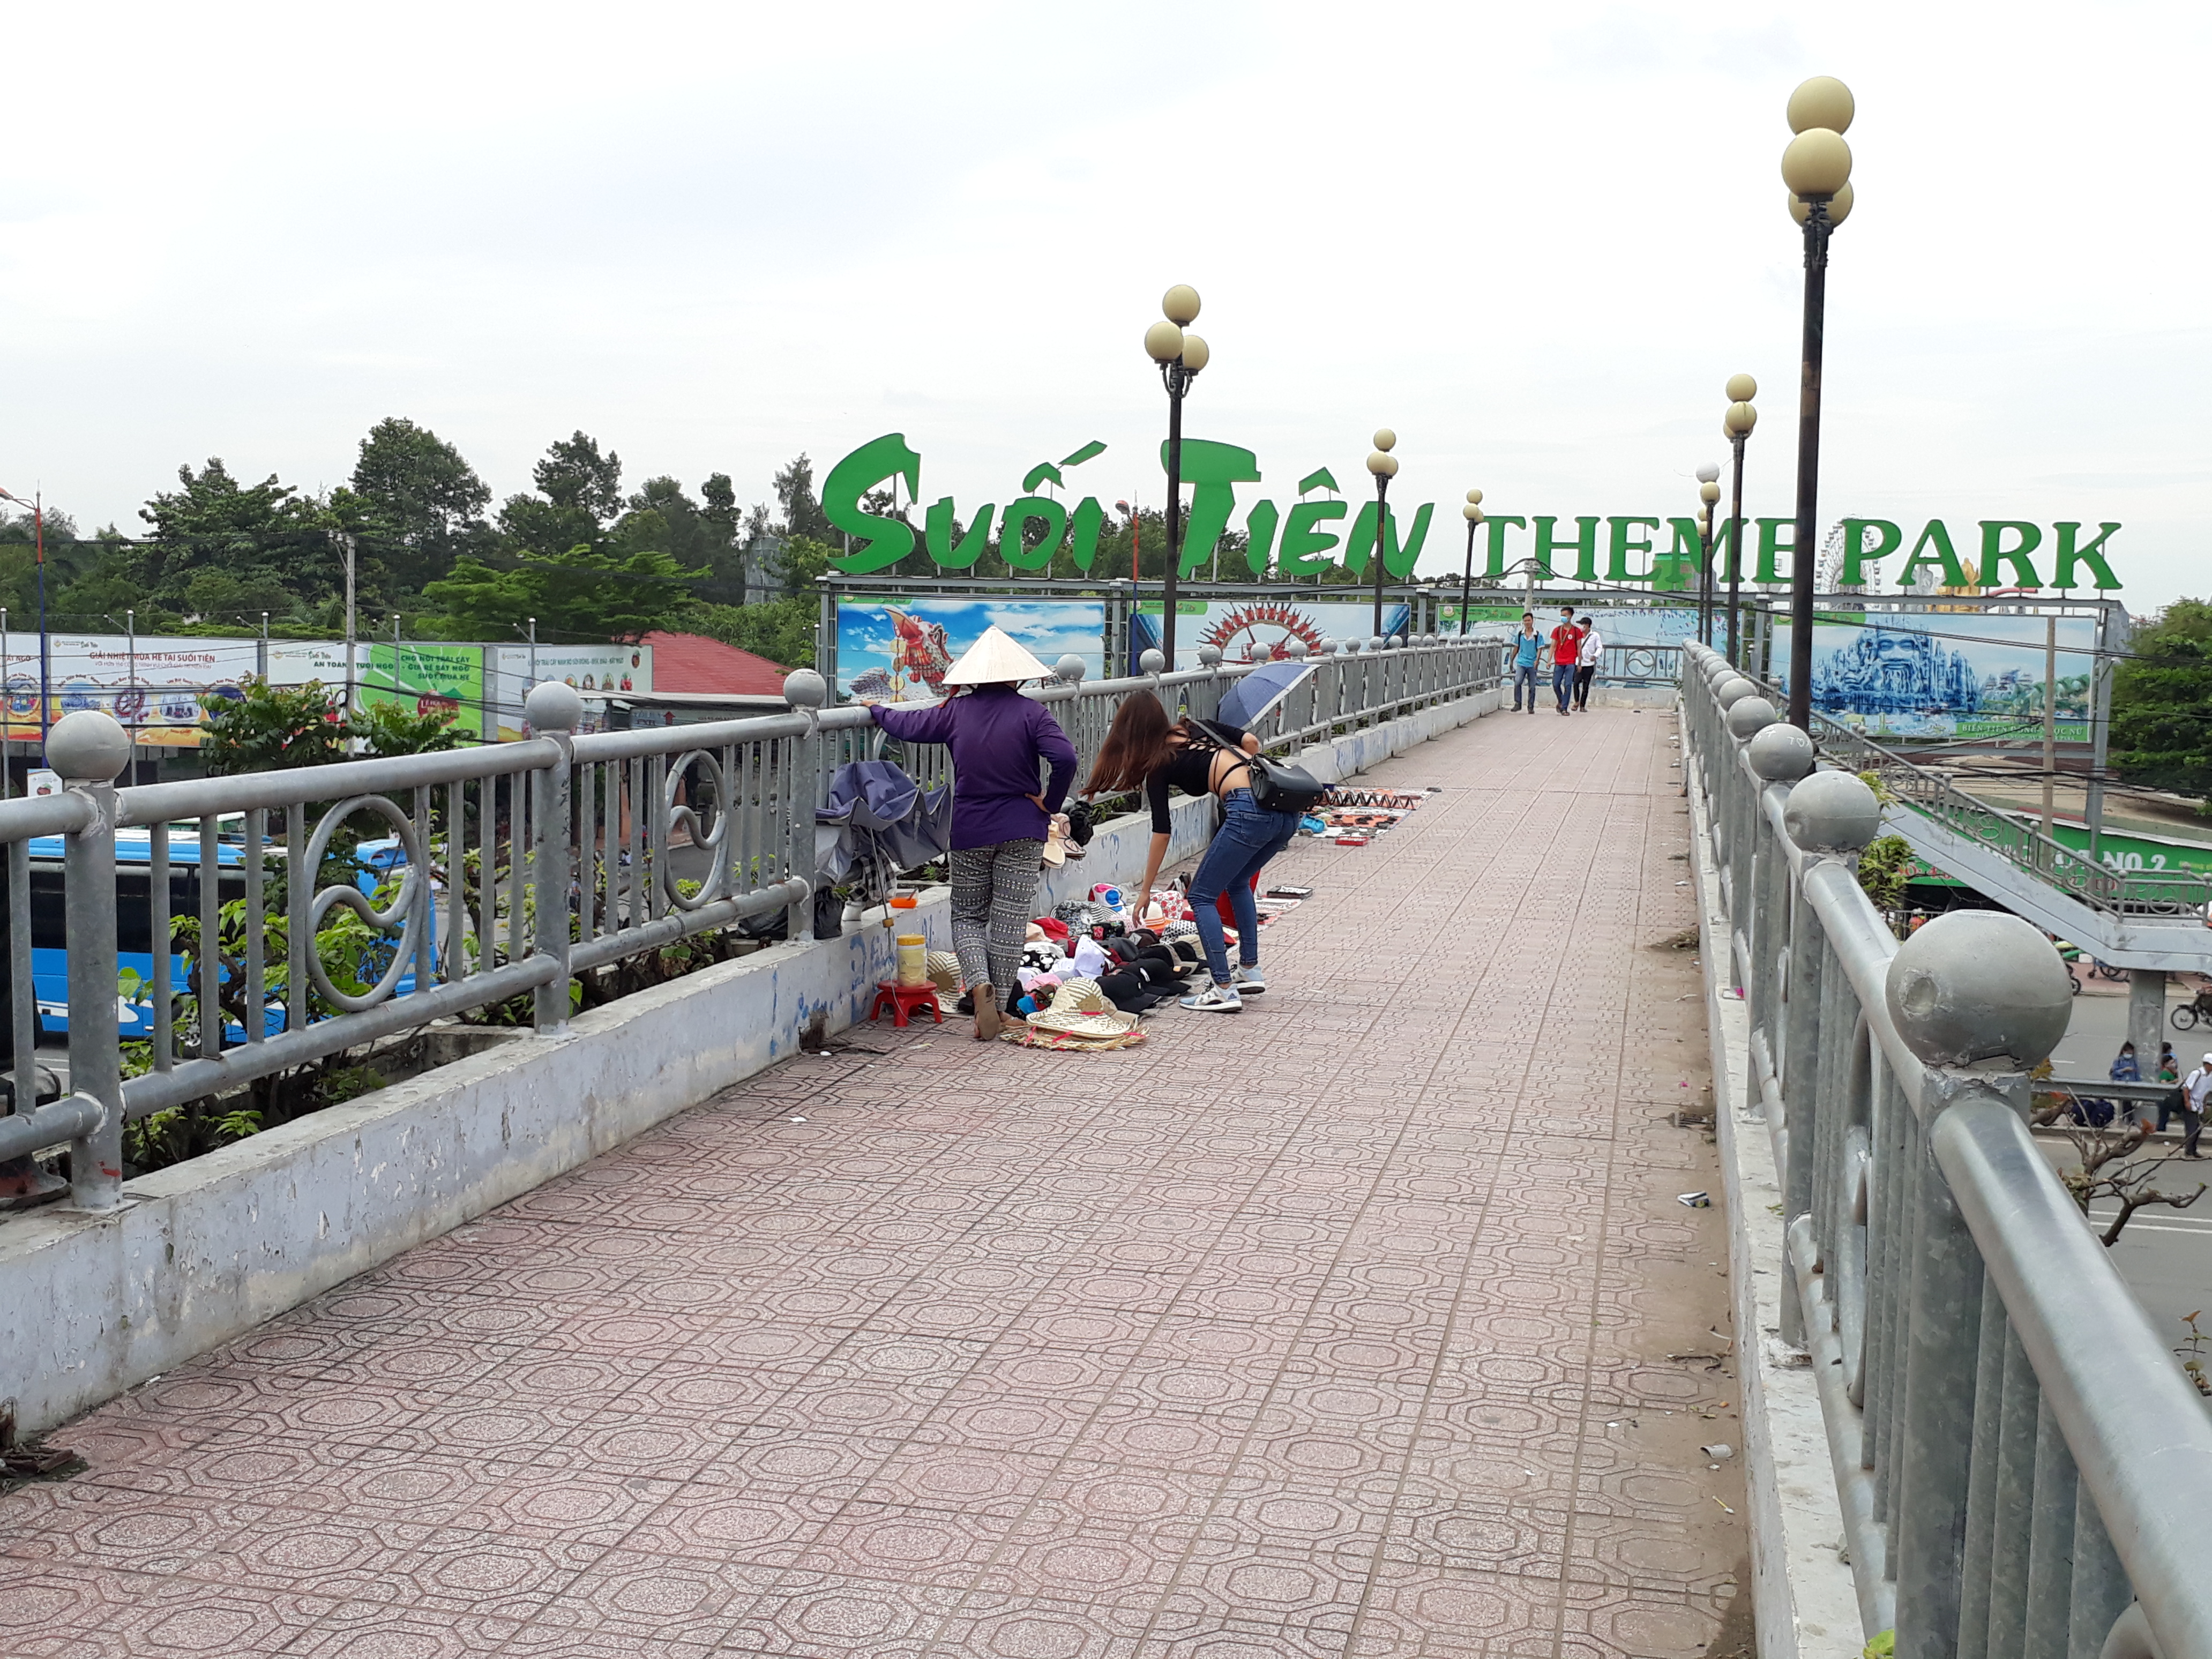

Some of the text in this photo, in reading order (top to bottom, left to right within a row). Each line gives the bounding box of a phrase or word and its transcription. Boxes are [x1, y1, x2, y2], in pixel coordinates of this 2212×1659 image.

[1478, 516, 2123, 589] THEME PARK
[2150, 854, 2166, 870] 2
